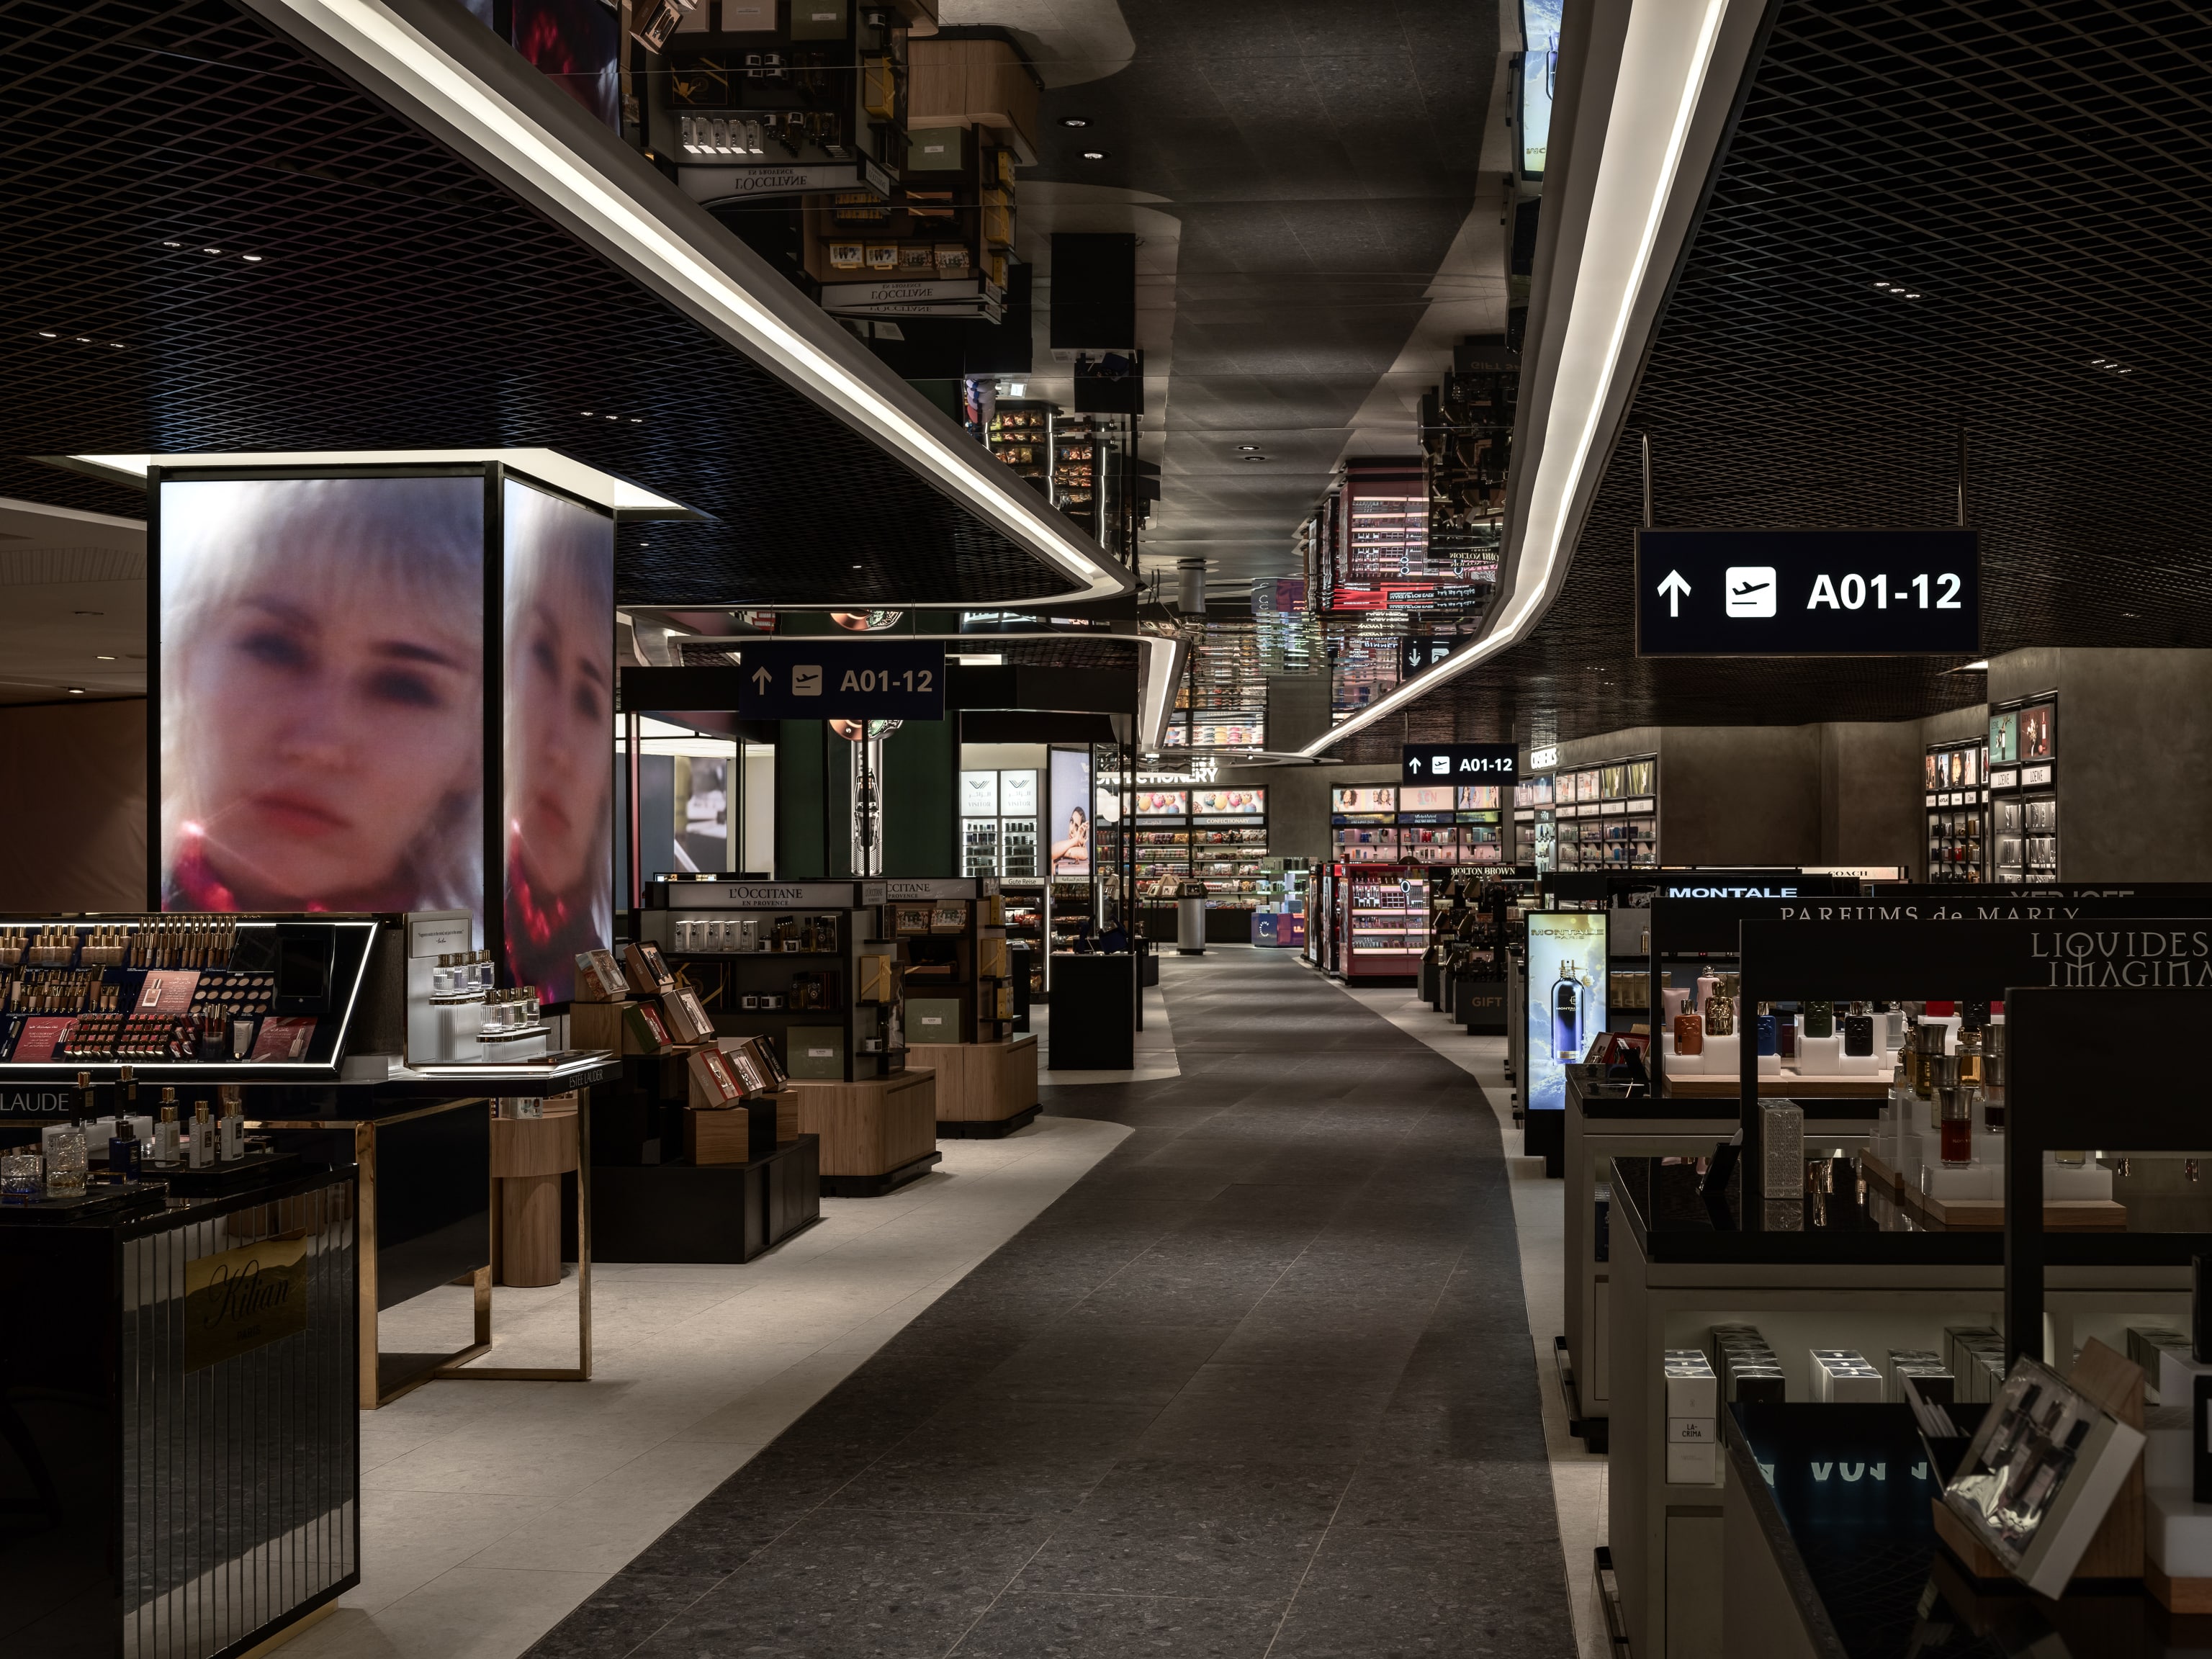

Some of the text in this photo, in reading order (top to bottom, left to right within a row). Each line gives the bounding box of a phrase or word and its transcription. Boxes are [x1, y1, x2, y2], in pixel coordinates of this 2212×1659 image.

[1807, 573, 1962, 610] A01-12
[840, 670, 933, 693] A01-12
[1459, 758, 1513, 772] A01-12
[1997, 773, 2010, 786] LOEWE
[2030, 770, 2043, 783] LOEWE
[1451, 867, 1515, 876] MOLTON BROWN
[729, 886, 803, 899] L'OCCITANE
[886, 884, 930, 893] CCITANE
[1669, 887, 1798, 898] MONTALE
[2031, 931, 2209, 958] LIQUIDES
[1471, 997, 1503, 1007] GIFT
[584, 1069, 603, 1084] LAUDER
[0, 1093, 70, 1111] LAUDE
[204, 1259, 289, 1331] Kilian
